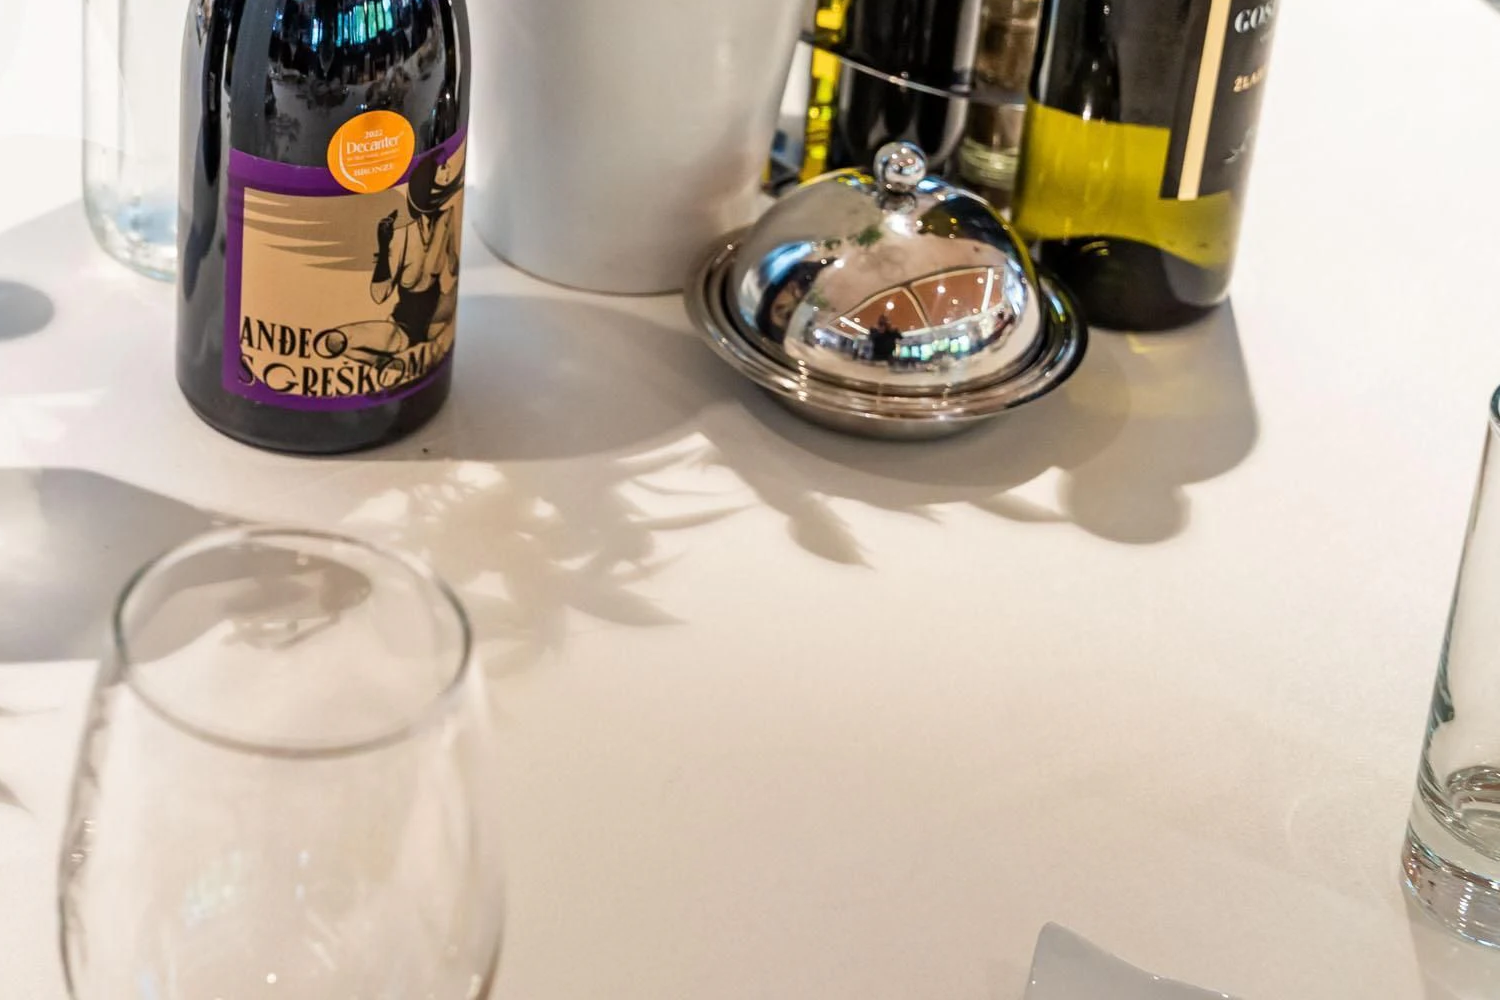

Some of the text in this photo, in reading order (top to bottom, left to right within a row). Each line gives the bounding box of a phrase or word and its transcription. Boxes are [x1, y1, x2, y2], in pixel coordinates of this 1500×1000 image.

[346, 136, 399, 155] Decanter
[240, 316, 348, 360] ANĐEO
[239, 354, 255, 386] S
